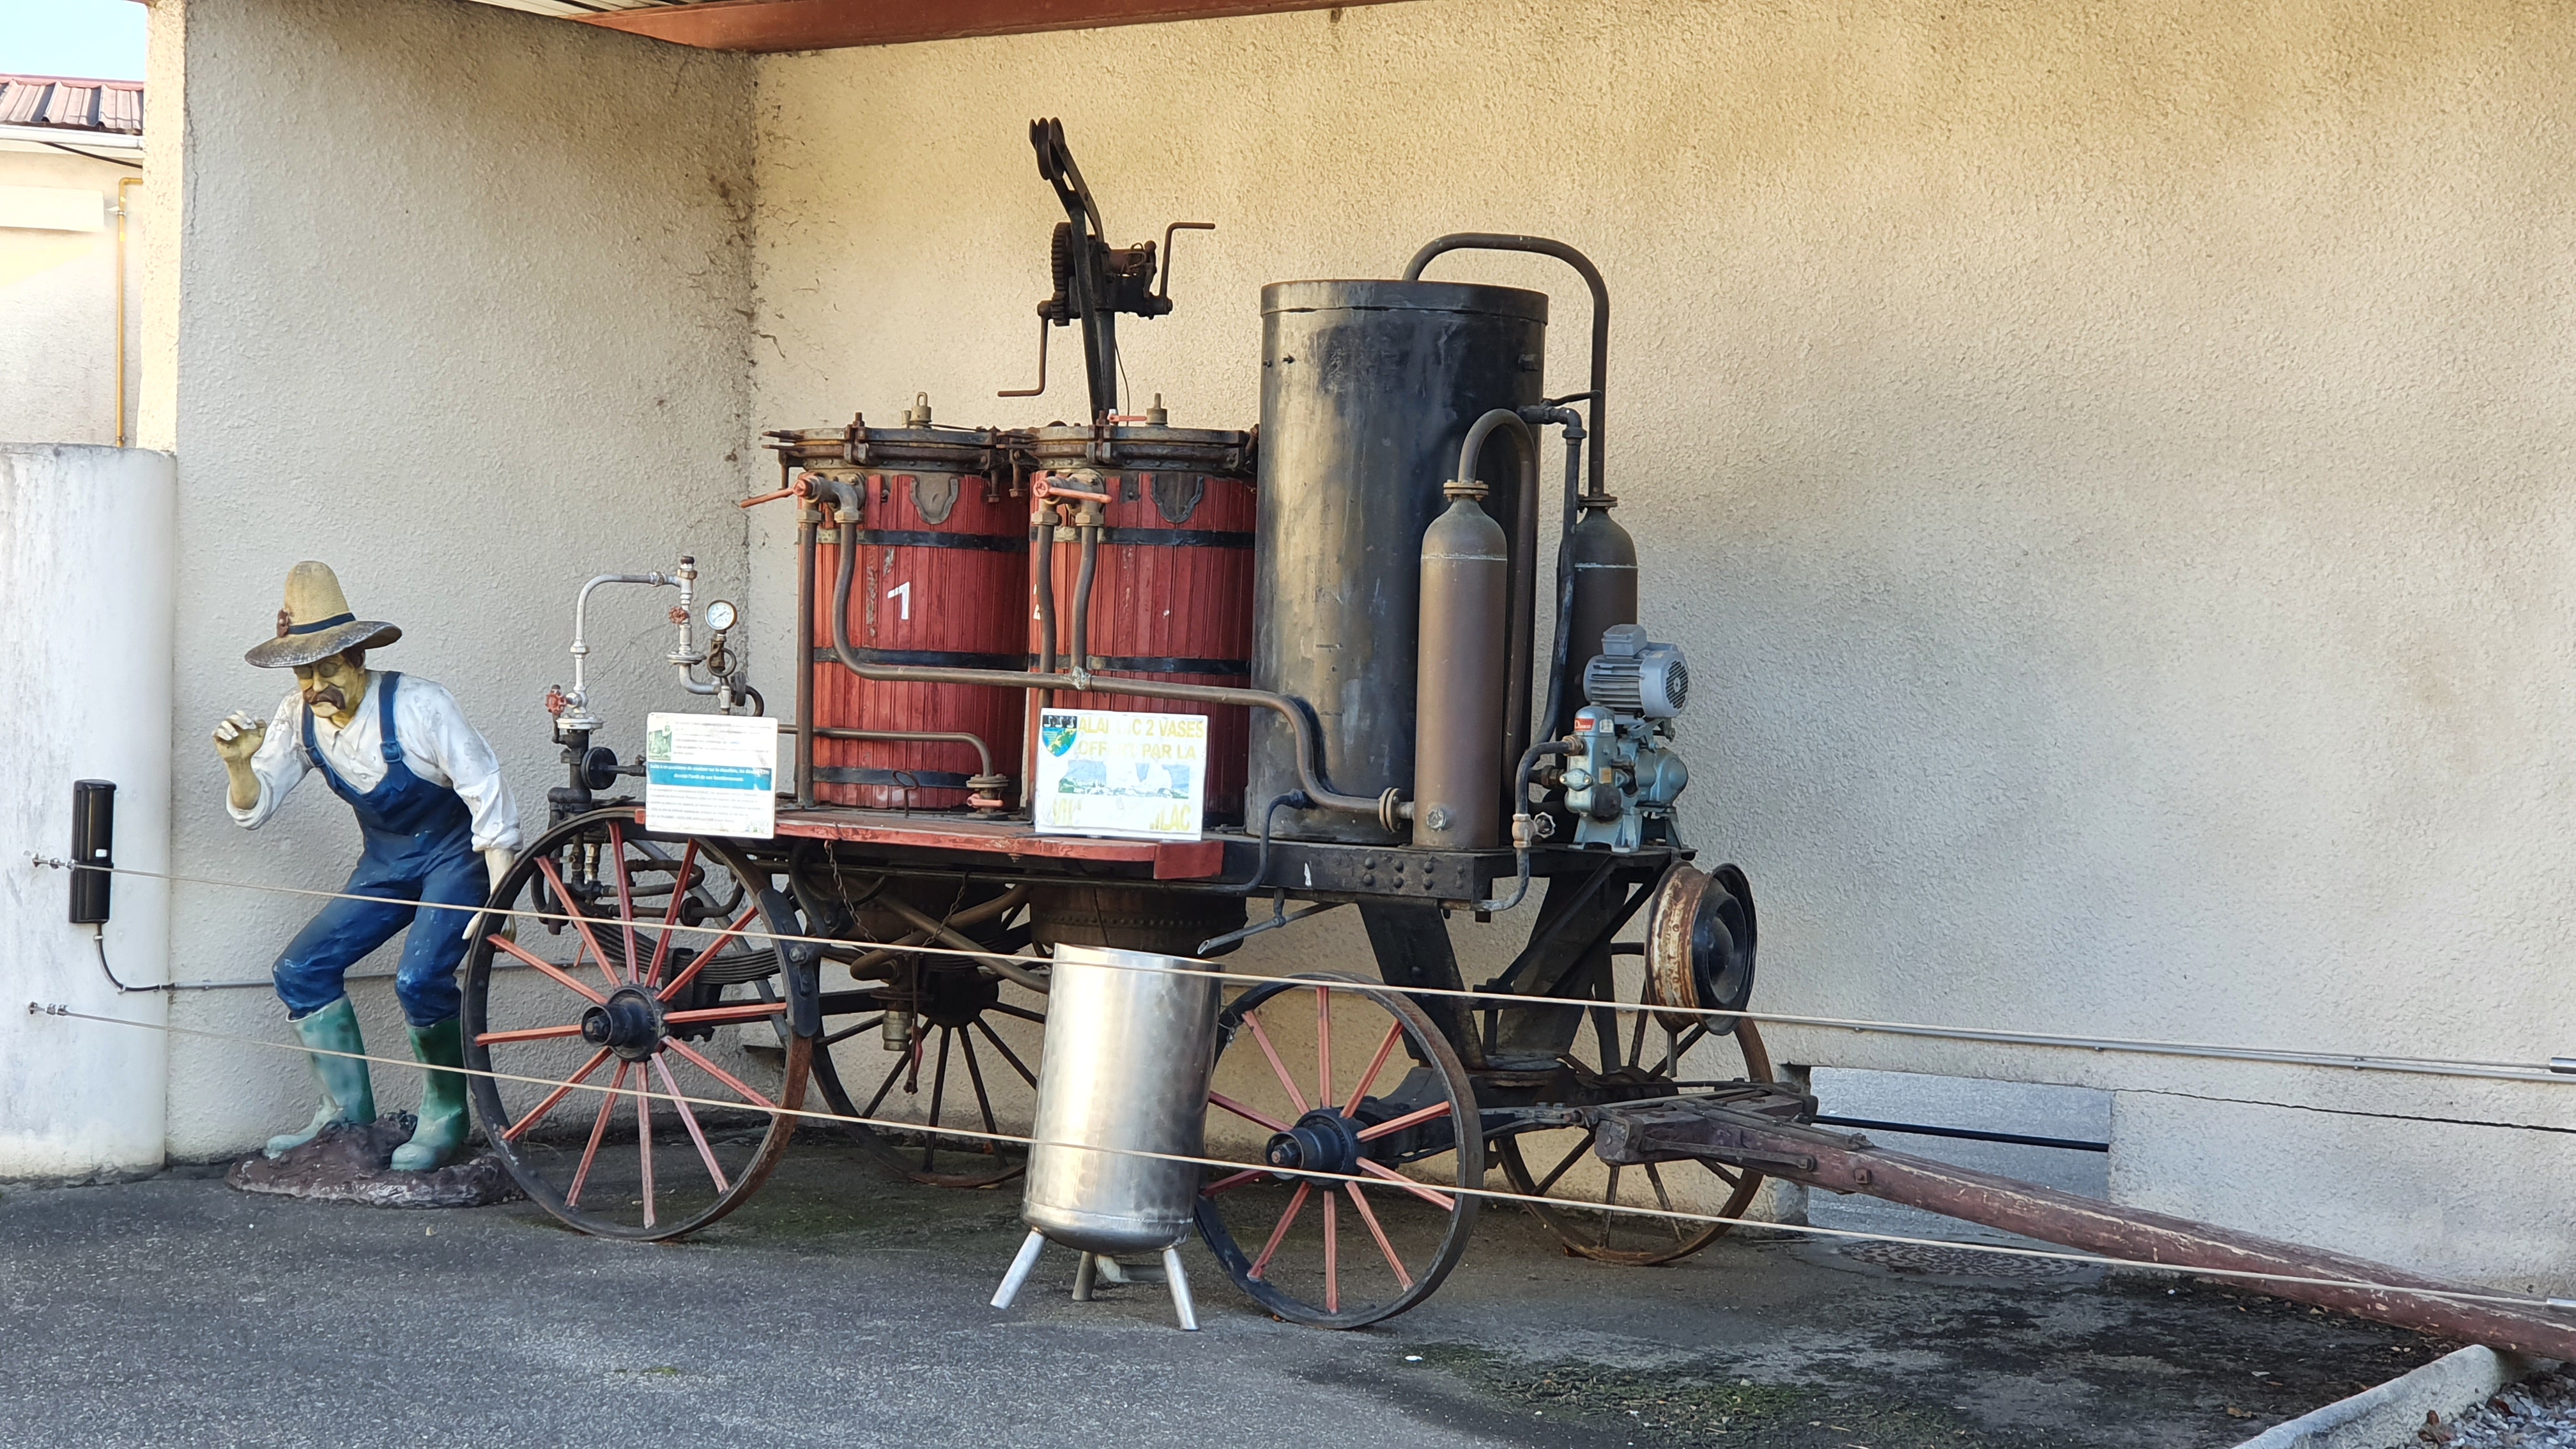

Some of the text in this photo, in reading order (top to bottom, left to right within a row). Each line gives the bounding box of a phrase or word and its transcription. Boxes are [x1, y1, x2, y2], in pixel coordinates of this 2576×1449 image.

[887, 581, 910, 620] 1
[1146, 719, 1154, 736] 2
[1159, 719, 1204, 739] VASES
[1142, 743, 1172, 759] PAR
[1177, 744, 1196, 760] LA
